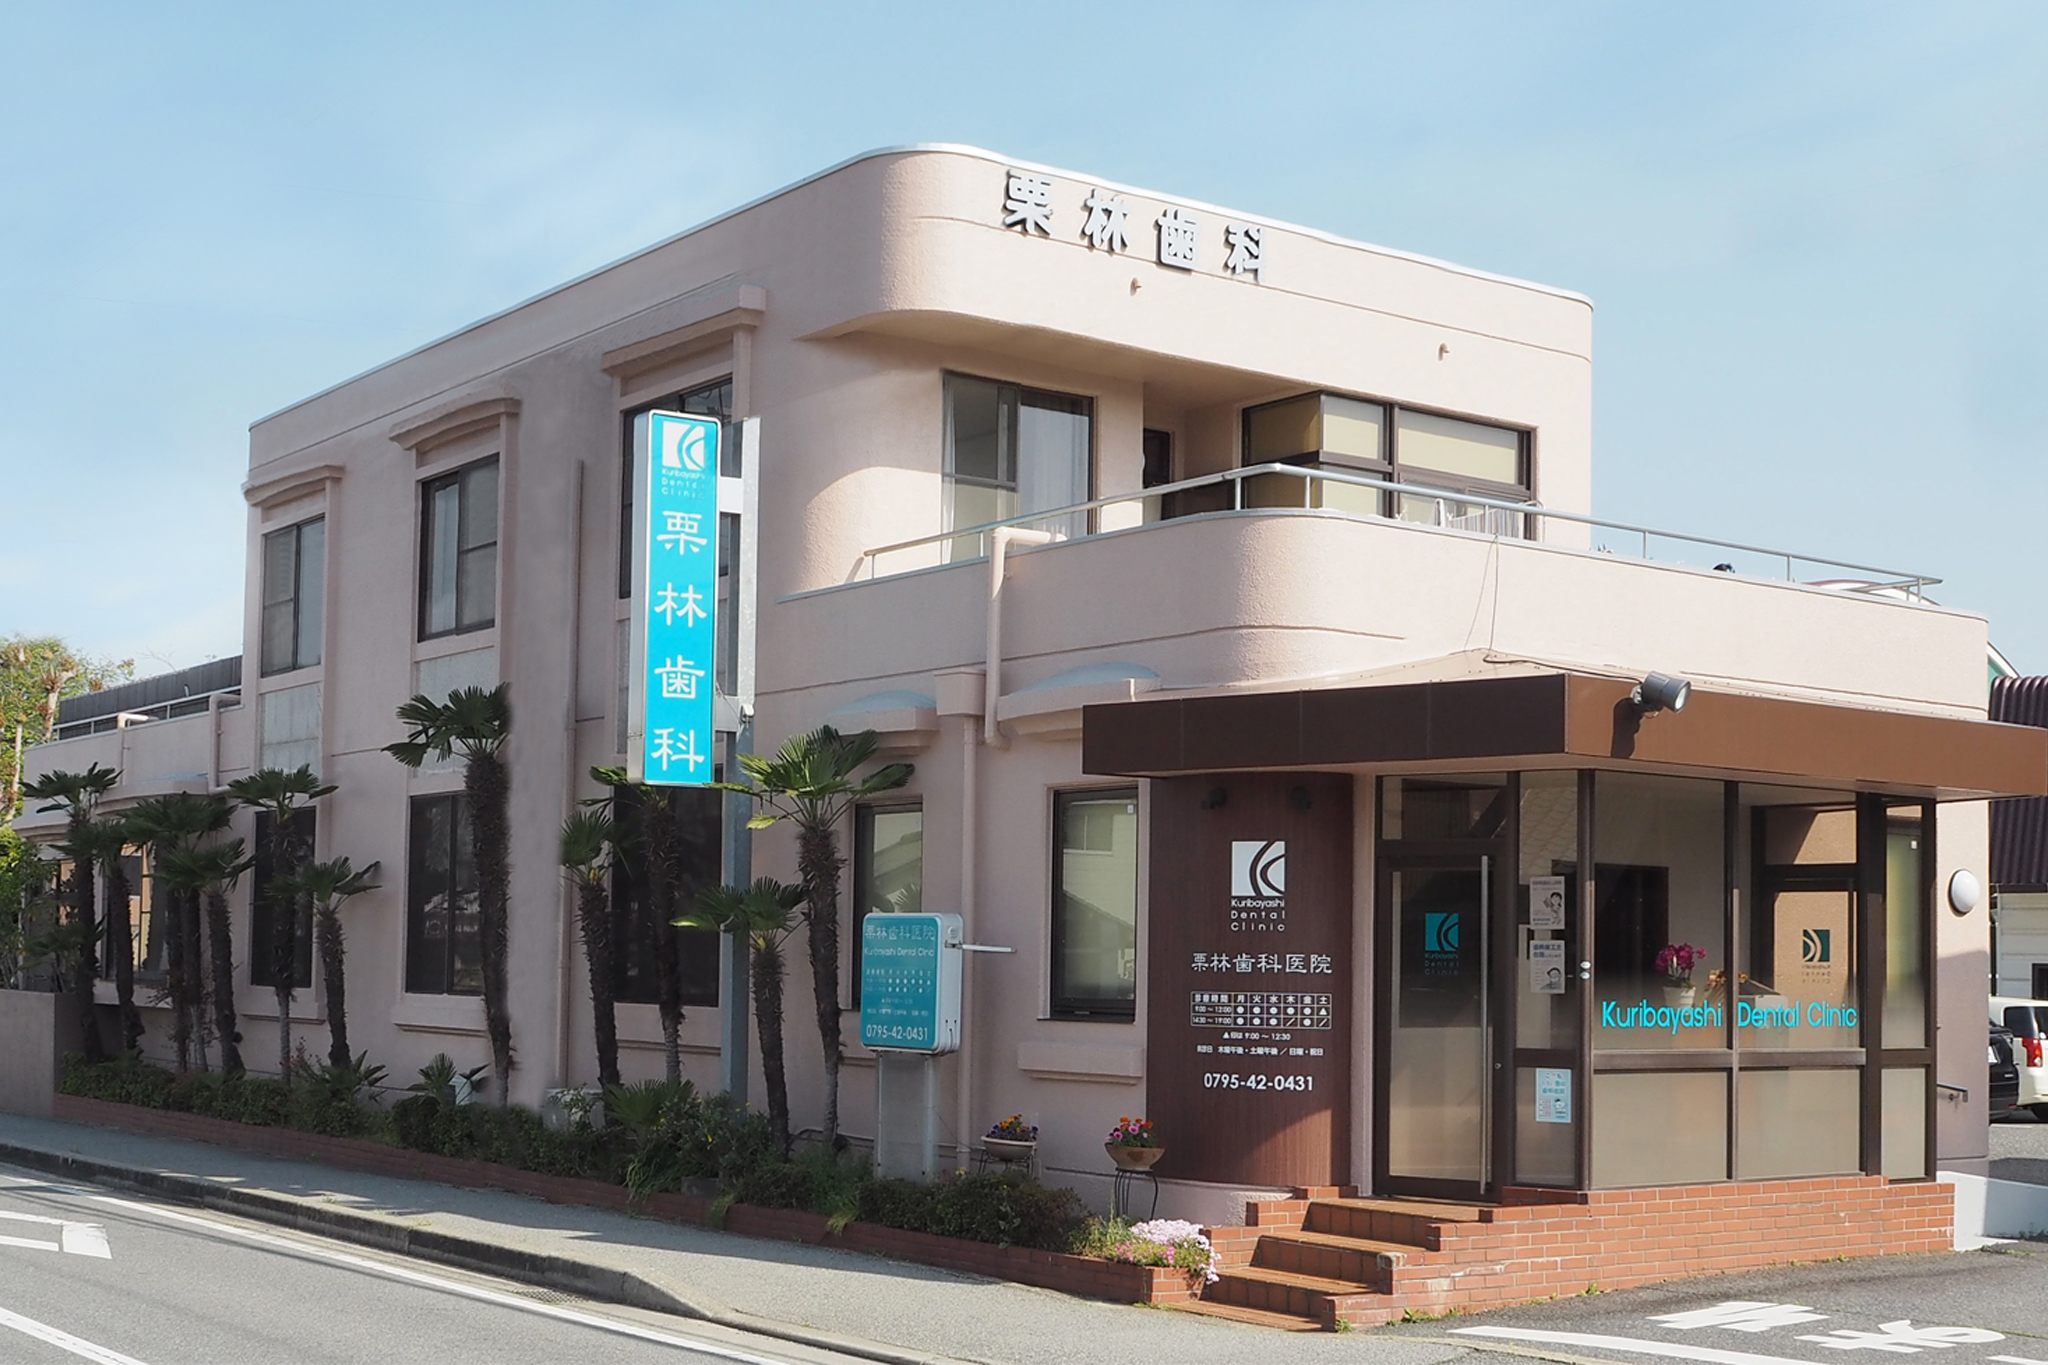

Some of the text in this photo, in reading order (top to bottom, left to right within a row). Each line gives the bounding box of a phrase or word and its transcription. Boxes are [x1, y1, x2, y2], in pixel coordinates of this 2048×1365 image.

[1001, 171, 1264, 284] 栗林歯科
[651, 510, 708, 773] 栗林歯科
[1231, 898, 1285, 909] Kuribayashi
[1231, 910, 1285, 919] Dental
[1231, 922, 1285, 931] Clinic
[1191, 953, 1333, 974] 栗林歯科医院
[1237, 994, 1245, 1003] 月
[1252, 994, 1261, 1003] 火
[1269, 995, 1278, 1004] 水
[1286, 995, 1295, 1004] 木
[1319, 996, 1328, 1005] 土
[1602, 1000, 1858, 1034] Kuribayashi Dental Clinic
[866, 1024, 928, 1041] 0795-42-0431
[1203, 1073, 1313, 1091] 0795-42-0431
